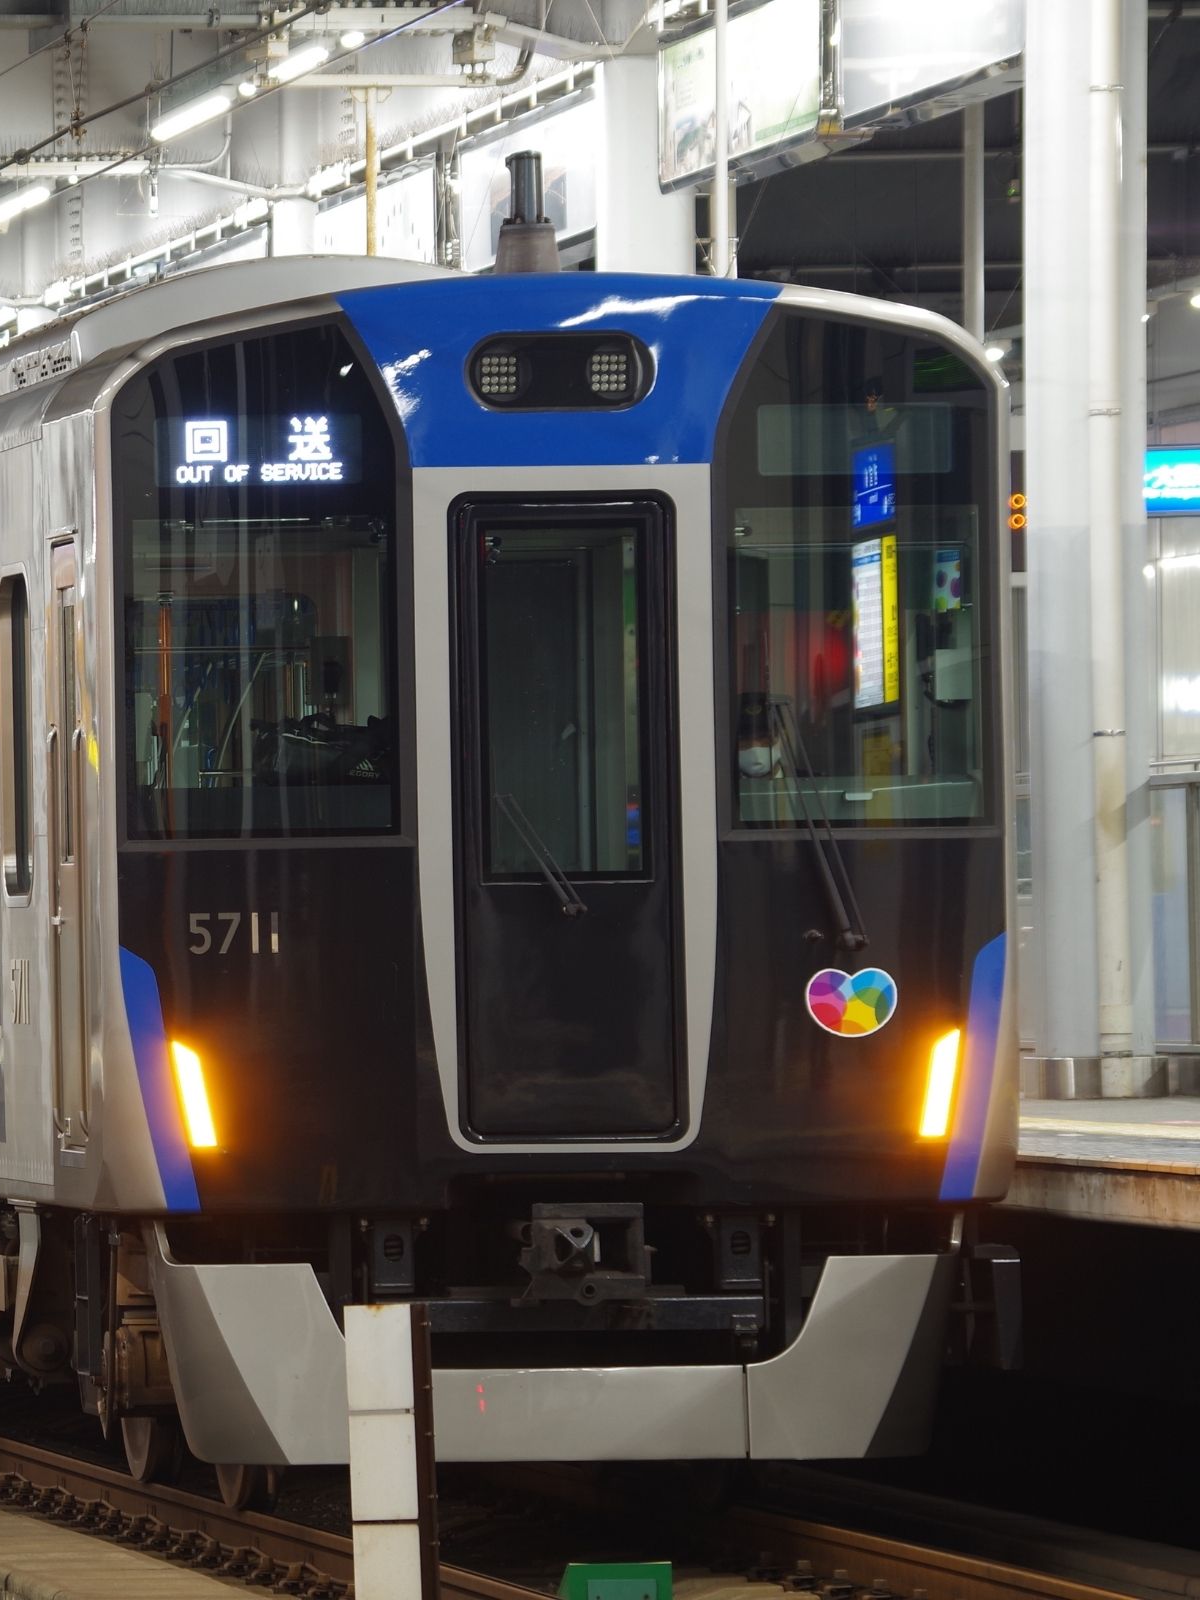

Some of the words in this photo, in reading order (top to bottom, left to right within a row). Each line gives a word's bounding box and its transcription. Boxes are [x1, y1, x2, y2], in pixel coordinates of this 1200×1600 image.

[176, 465, 213, 483] OUT
[224, 464, 250, 482] OF
[260, 462, 343, 481] SERVICE
[189, 911, 279, 955] 5711
